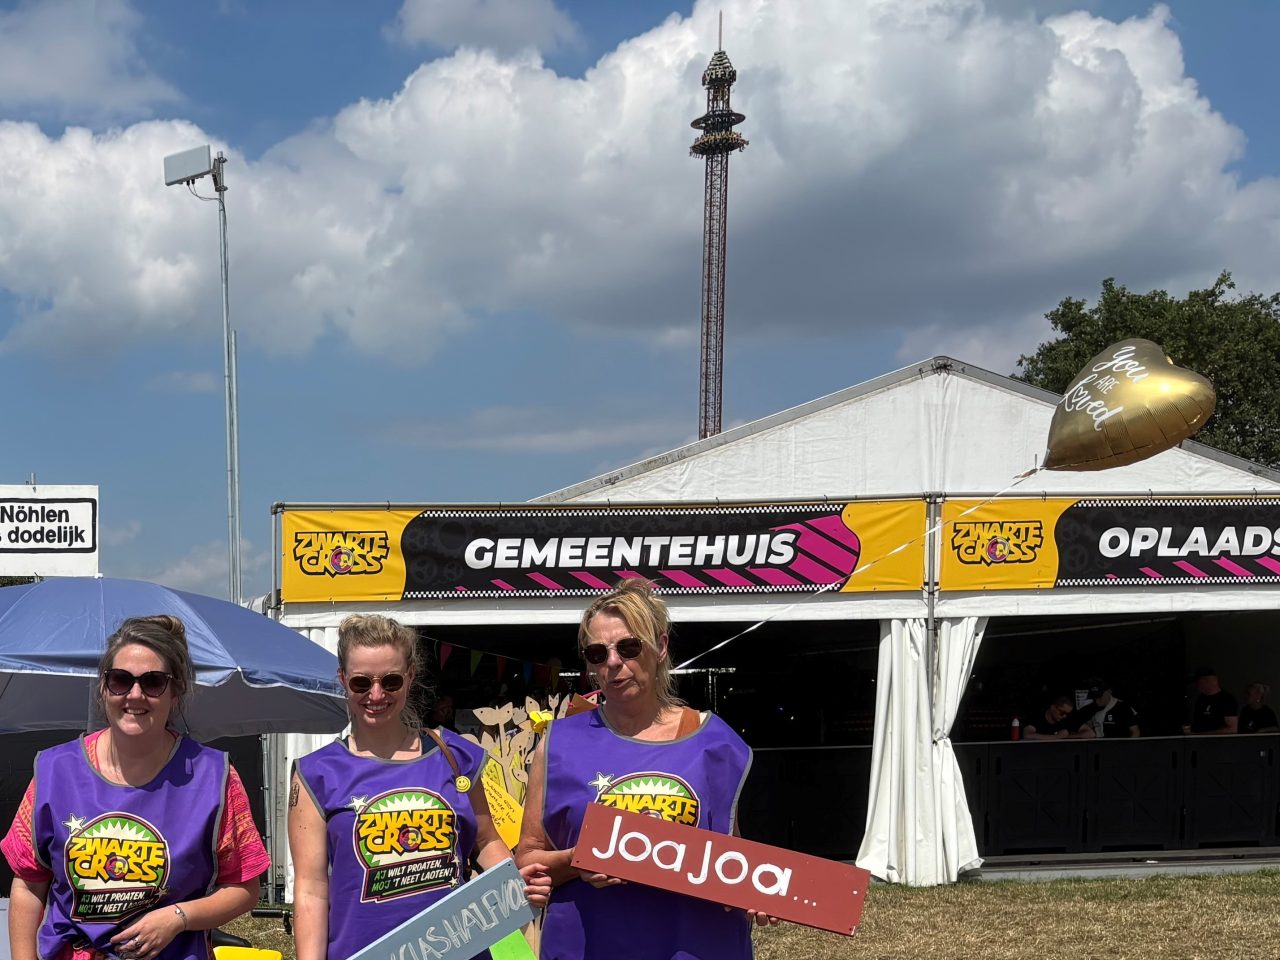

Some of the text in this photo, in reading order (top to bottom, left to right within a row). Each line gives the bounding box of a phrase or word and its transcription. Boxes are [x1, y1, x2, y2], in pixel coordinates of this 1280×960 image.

[1093, 346, 1148, 384] You
[1094, 375, 1119, 394] ARE
[0, 505, 69, 523] Nöhlen
[8, 526, 85, 547] dodelijk
[296, 532, 389, 557] ZWARTE
[954, 522, 1042, 547] ZWARTE
[301, 550, 384, 575] CROSS
[464, 533, 798, 571] GEMEENTEHUIS
[958, 539, 1036, 564] CROSS
[359, 810, 453, 838] ZWARTE
[69, 837, 165, 858] ZWARTE
[591, 815, 686, 872] Joa
[387, 866, 406, 878] WILT
[400, 873, 420, 886] NEET
[442, 889, 500, 949] HALF
